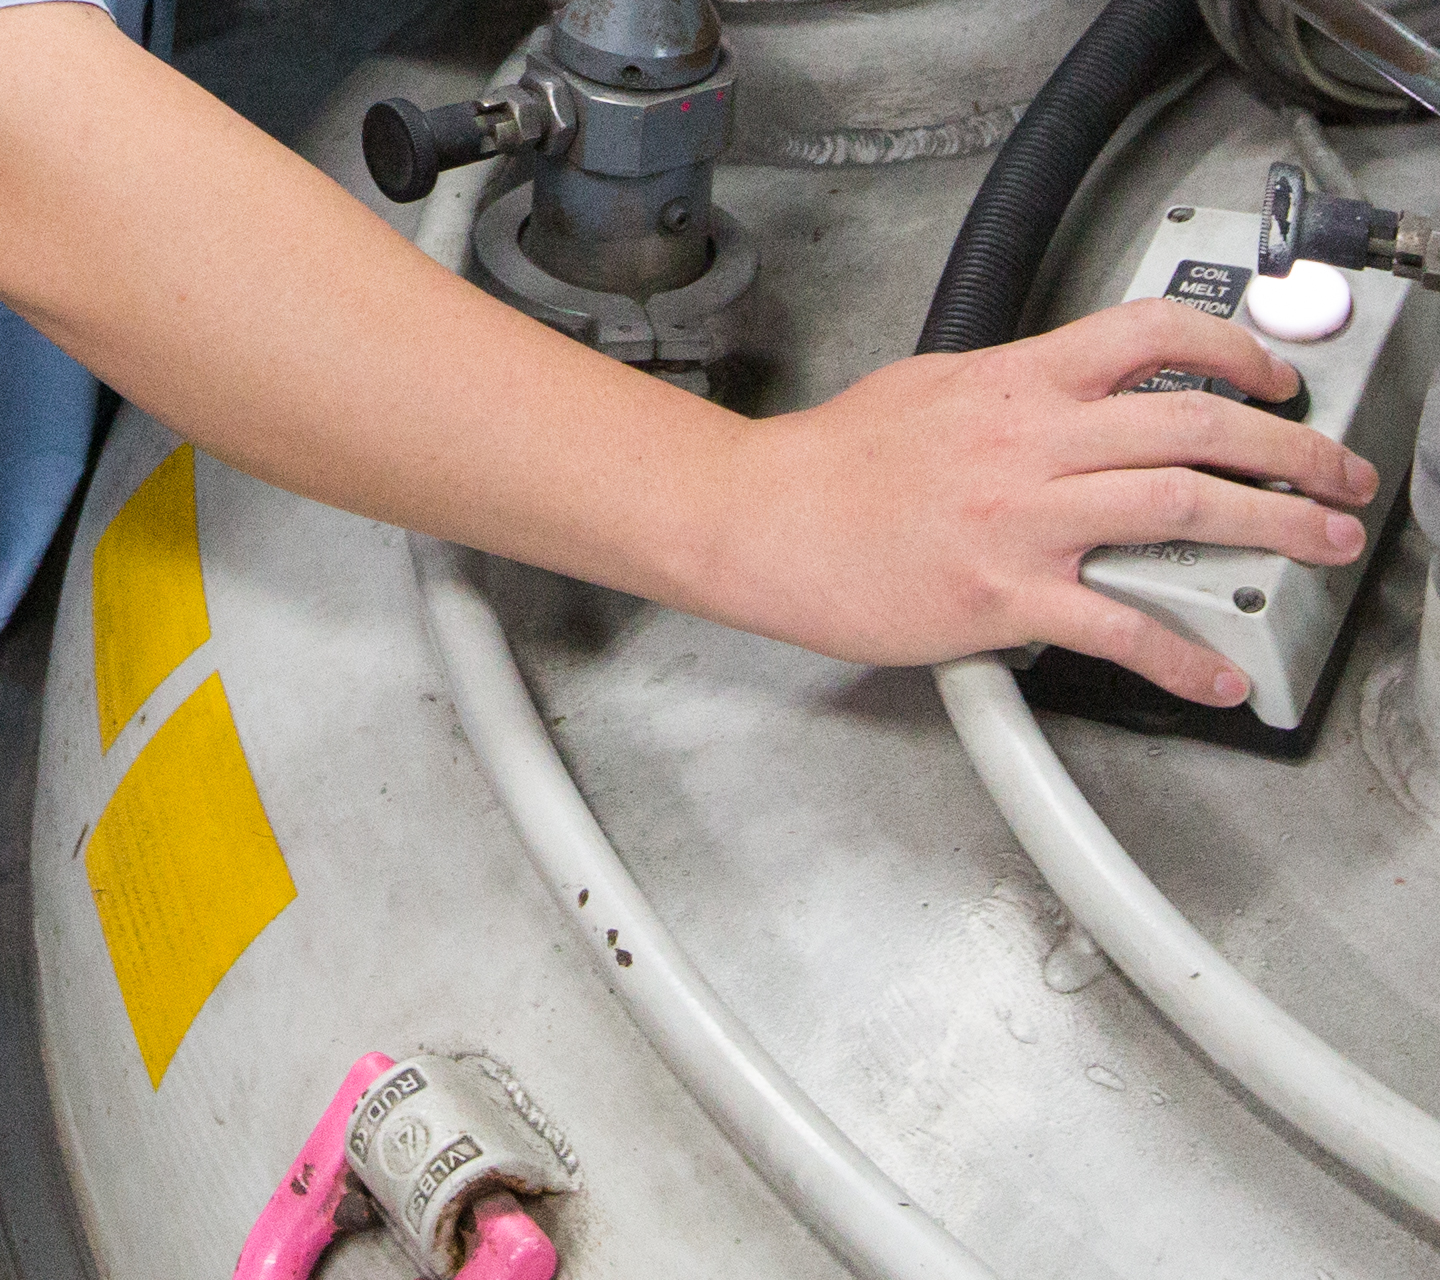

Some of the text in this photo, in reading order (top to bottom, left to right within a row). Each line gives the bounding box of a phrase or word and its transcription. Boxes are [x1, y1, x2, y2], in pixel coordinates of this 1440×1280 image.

[1179, 281, 1230, 297] MELT
[1191, 266, 1232, 282] COIL
[366, 1073, 419, 1123] RUD
[413, 1149, 468, 1210] VLBS
